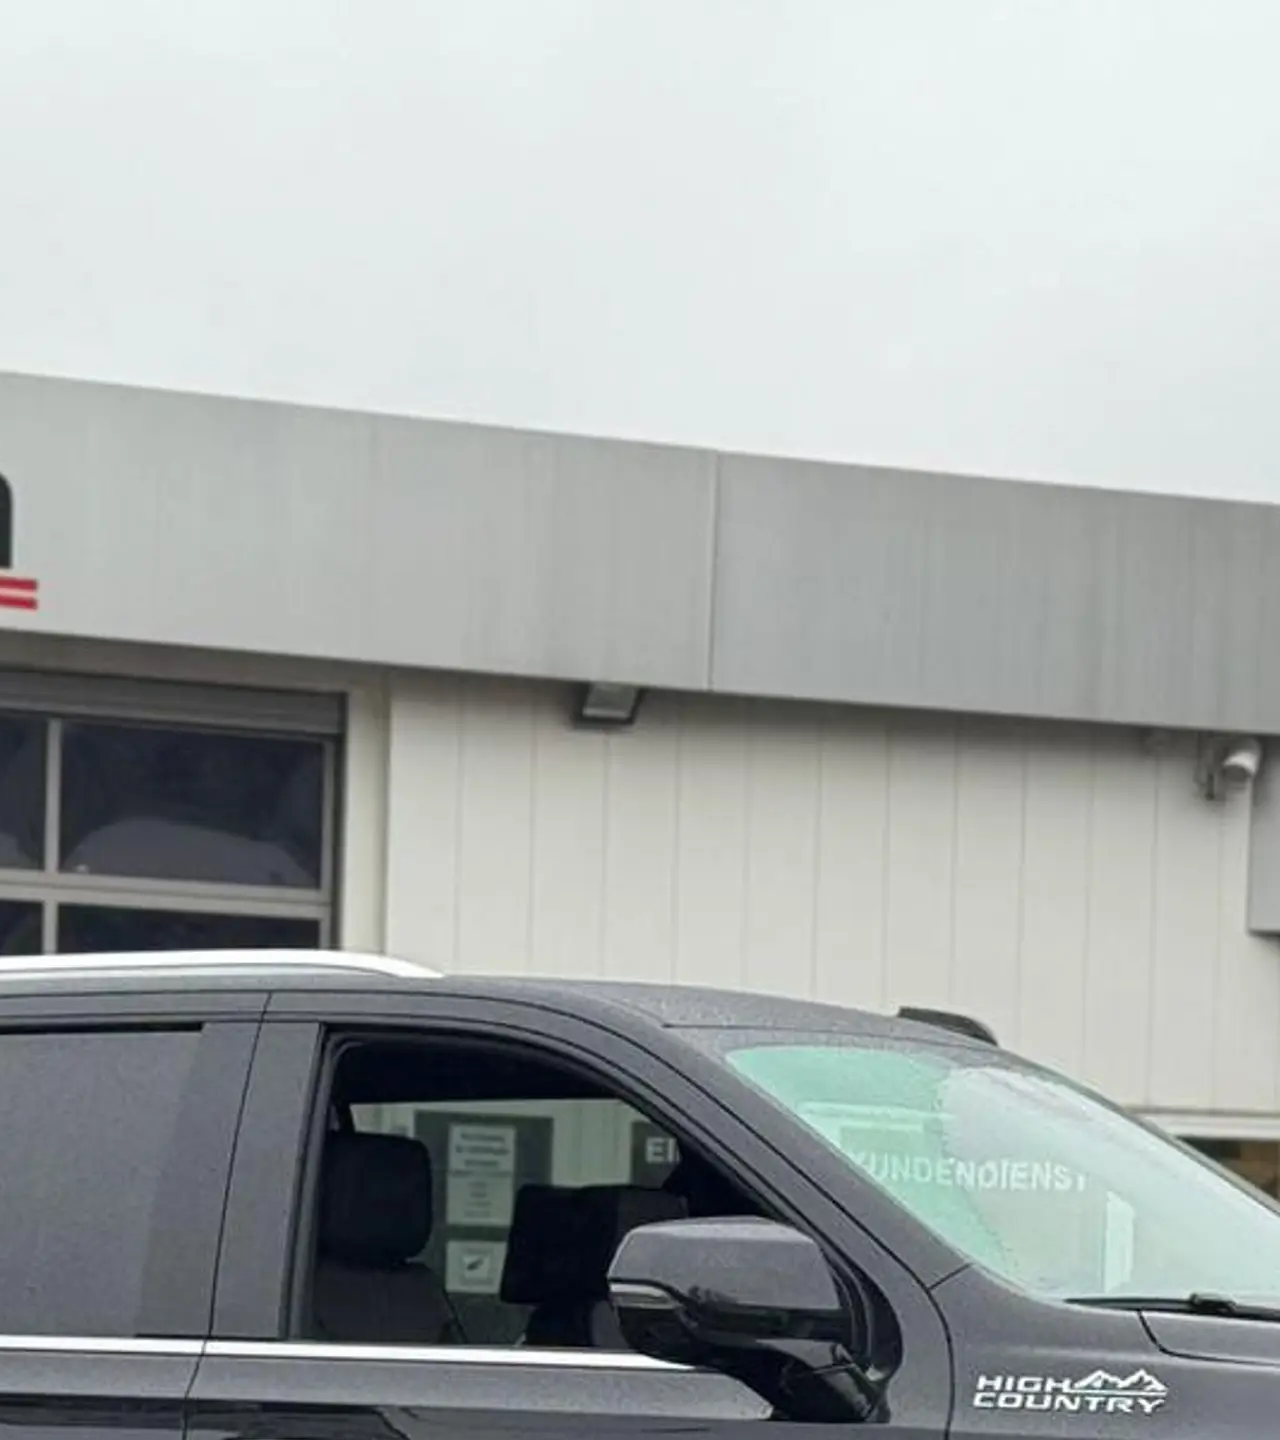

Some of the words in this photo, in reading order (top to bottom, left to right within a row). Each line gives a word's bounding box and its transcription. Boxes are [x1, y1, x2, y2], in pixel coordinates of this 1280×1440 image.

[646, 1137, 680, 1163] EI
[976, 1375, 1071, 1393] HIGH
[973, 1392, 1165, 1413] COUNTRY
